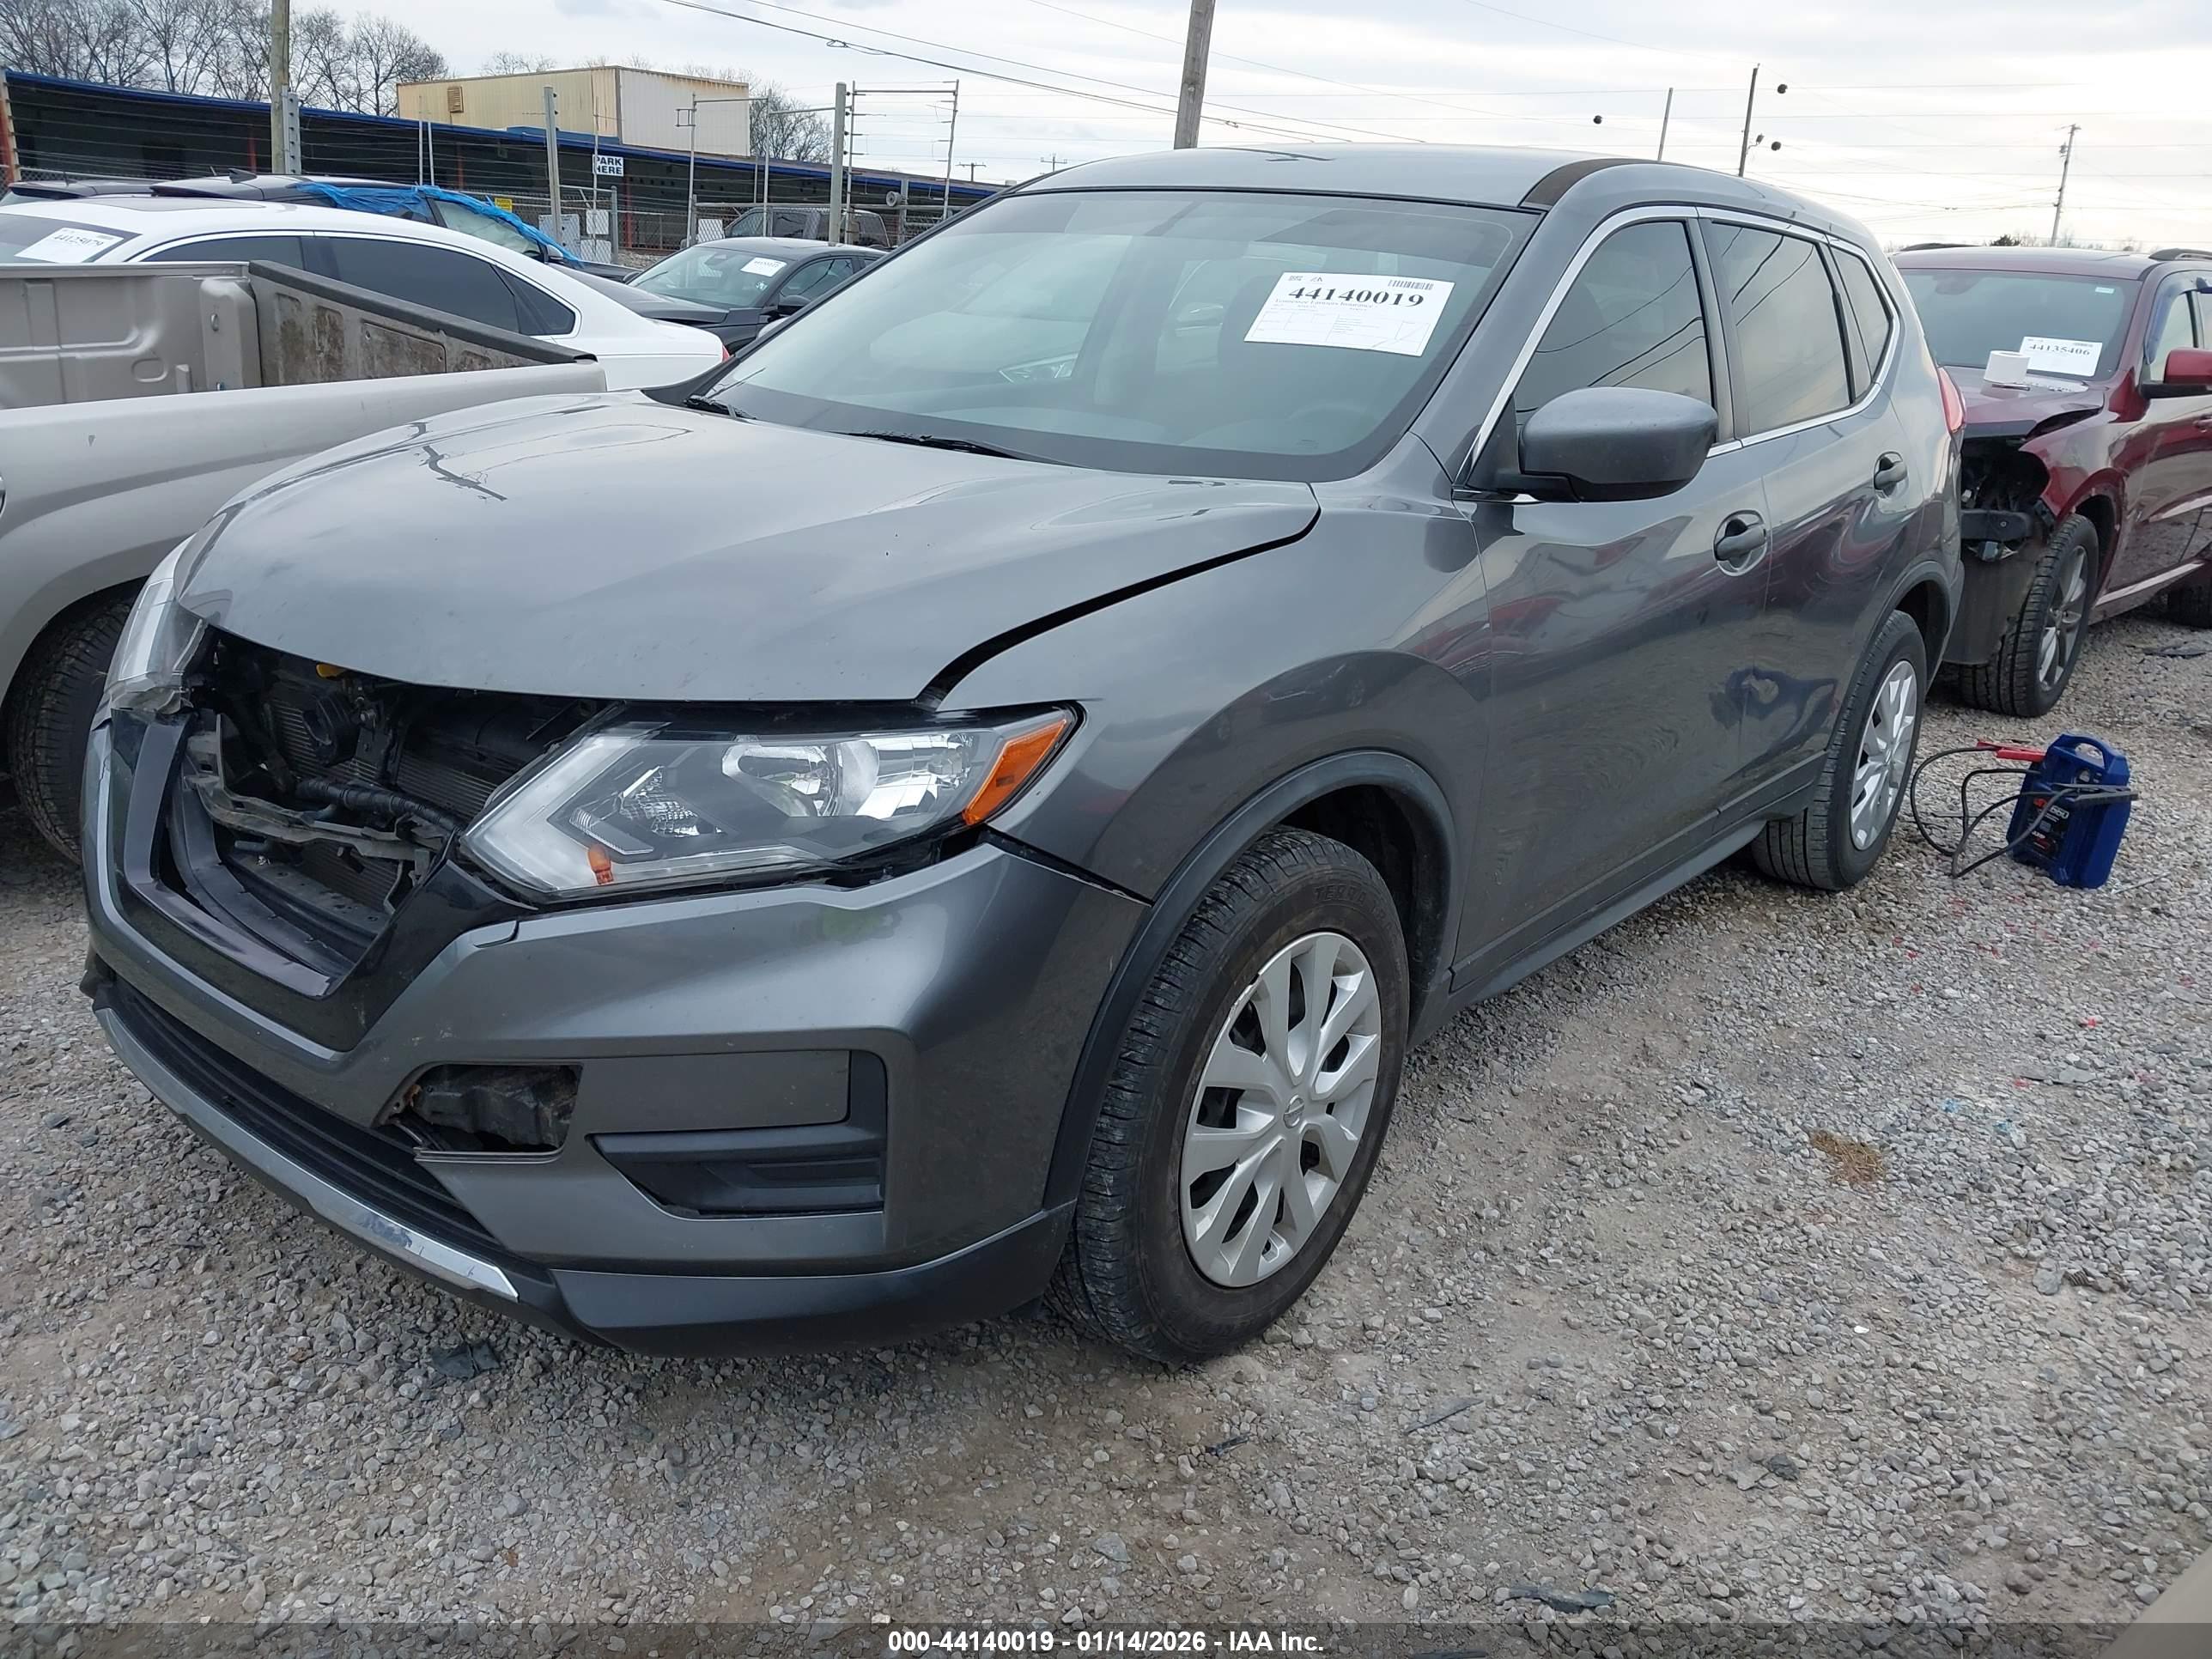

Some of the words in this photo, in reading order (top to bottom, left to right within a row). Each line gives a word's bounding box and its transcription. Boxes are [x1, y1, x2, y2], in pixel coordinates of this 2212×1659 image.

[595, 156, 623, 167] PARK
[596, 165, 623, 175] HERE
[1288, 287, 1425, 307] 44140019
[2029, 343, 2091, 356] 44135406
